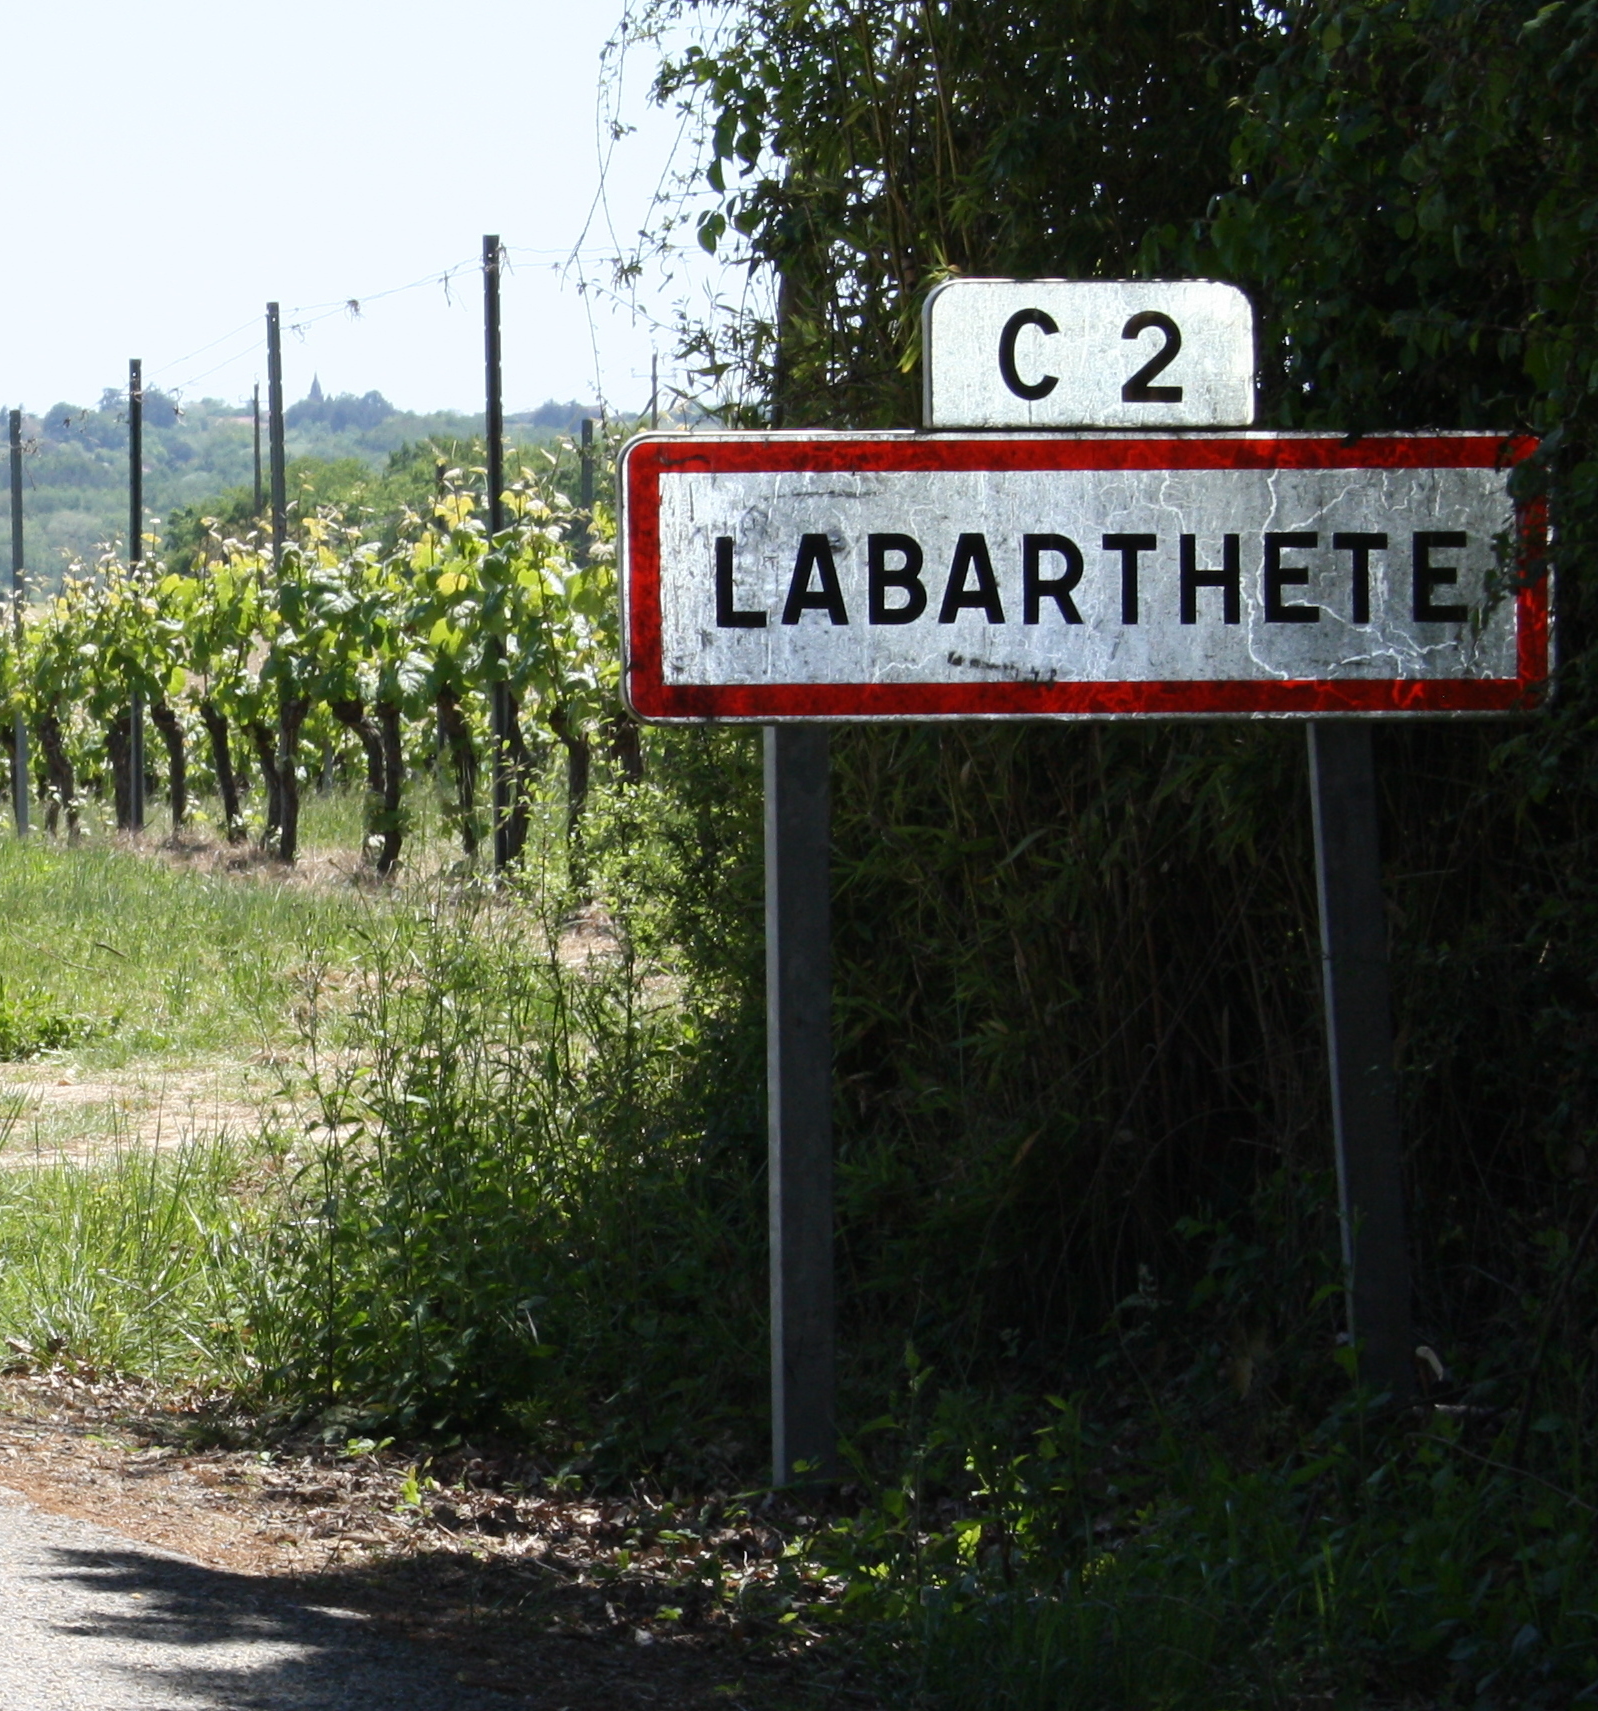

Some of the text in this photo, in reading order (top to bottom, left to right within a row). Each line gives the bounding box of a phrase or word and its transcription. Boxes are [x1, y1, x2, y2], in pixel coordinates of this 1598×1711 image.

[999, 308, 1183, 403] C 2
[715, 531, 1468, 628] LABARTHETE
